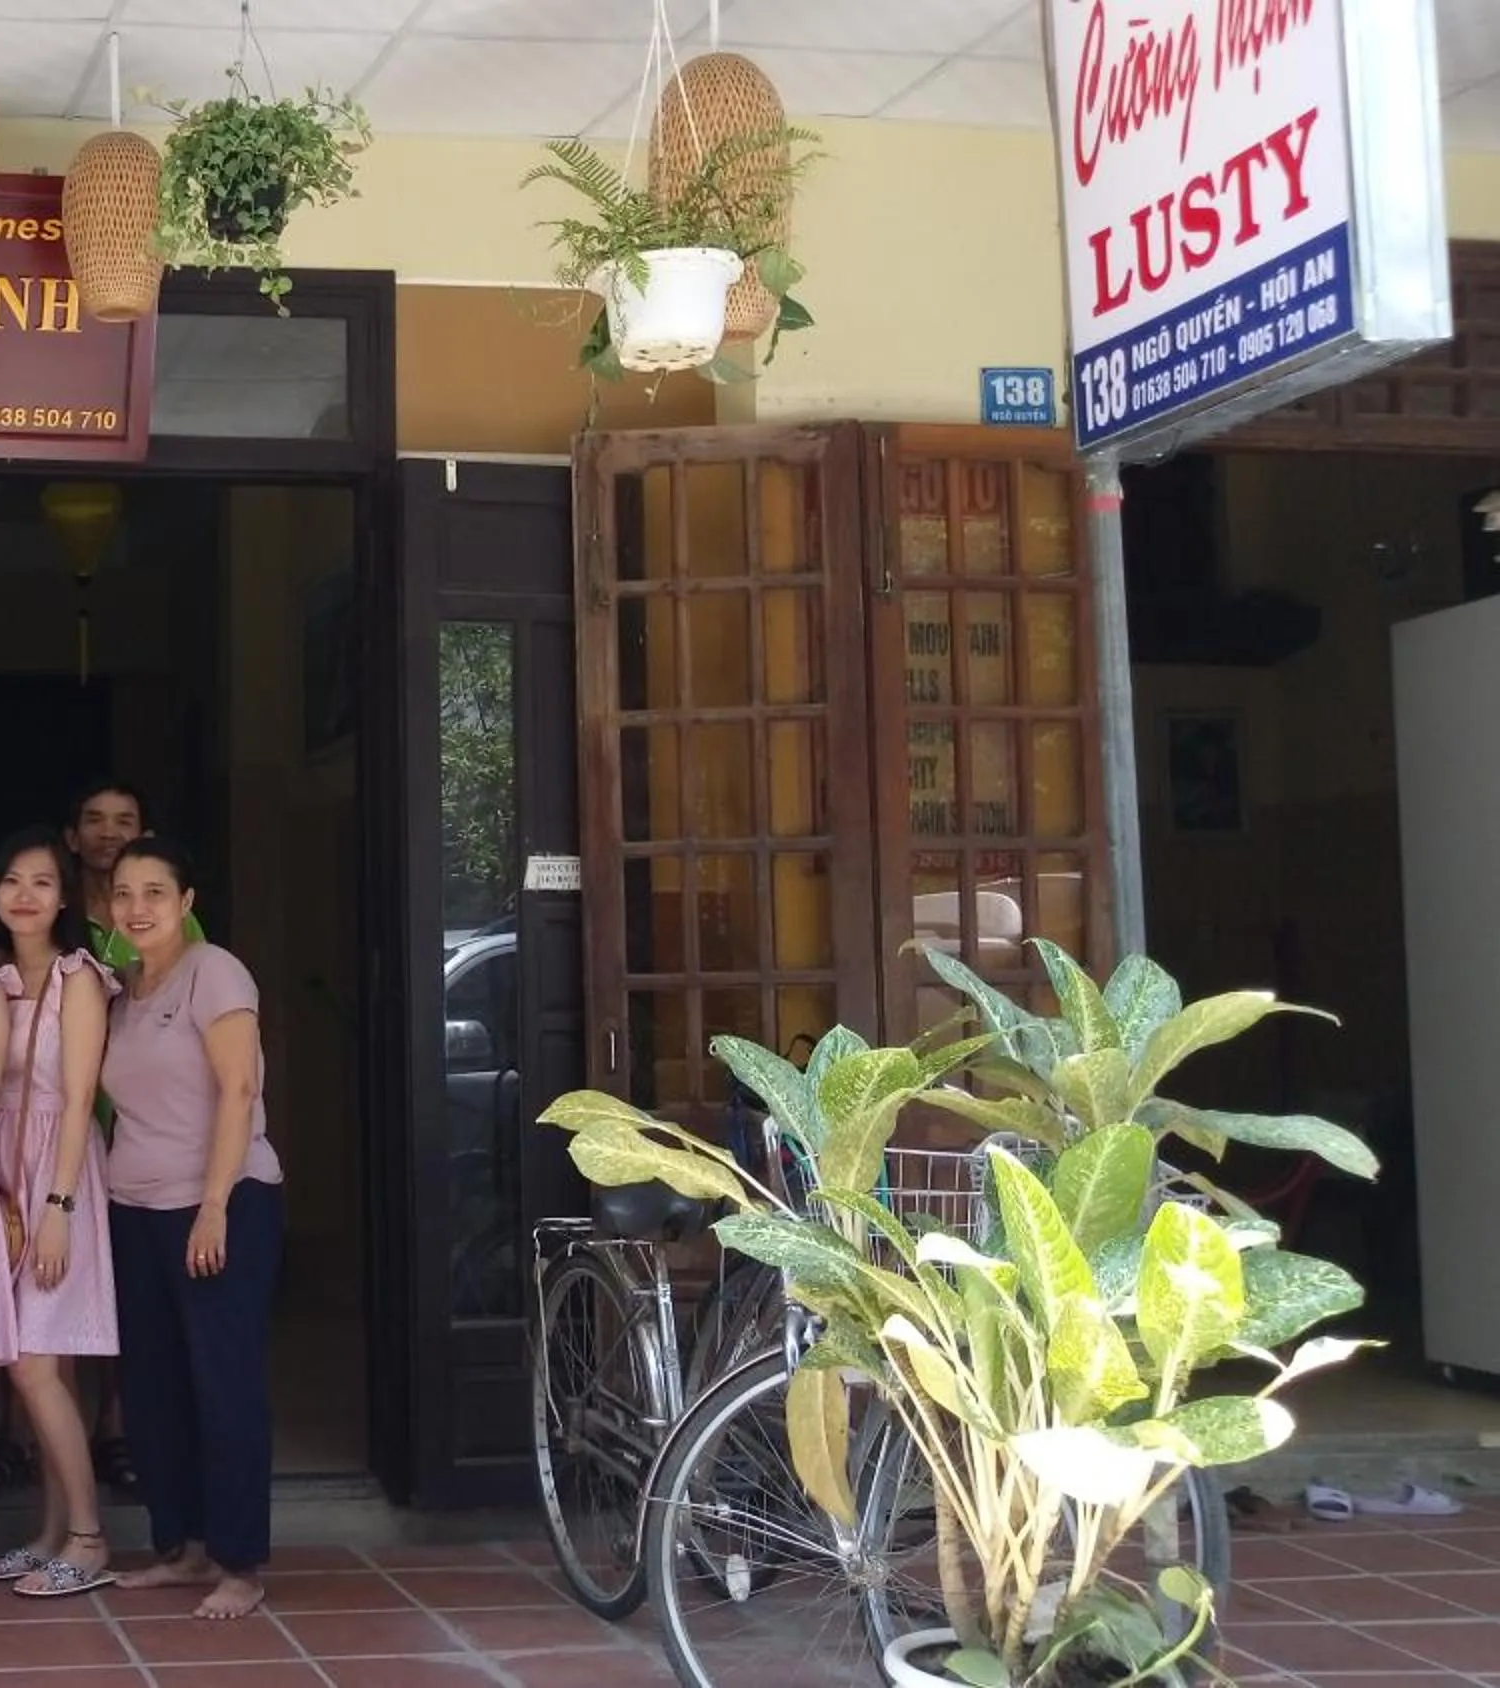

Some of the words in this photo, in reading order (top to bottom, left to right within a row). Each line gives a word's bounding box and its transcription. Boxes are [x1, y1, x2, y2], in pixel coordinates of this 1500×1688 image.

[1088, 106, 1319, 317] LUSTY
[1131, 326, 1171, 372] NGÔ
[1260, 266, 1297, 311] HỘI
[1303, 248, 1335, 292] AN
[991, 376, 1045, 407] 138
[1081, 349, 1127, 432] 138
[1132, 371, 1171, 411] 01638
[1173, 359, 1197, 394] 504
[1200, 346, 1226, 381] 710
[1238, 324, 1274, 364] 0905
[32, 408, 72, 427] 504
[80, 411, 117, 431] 710
